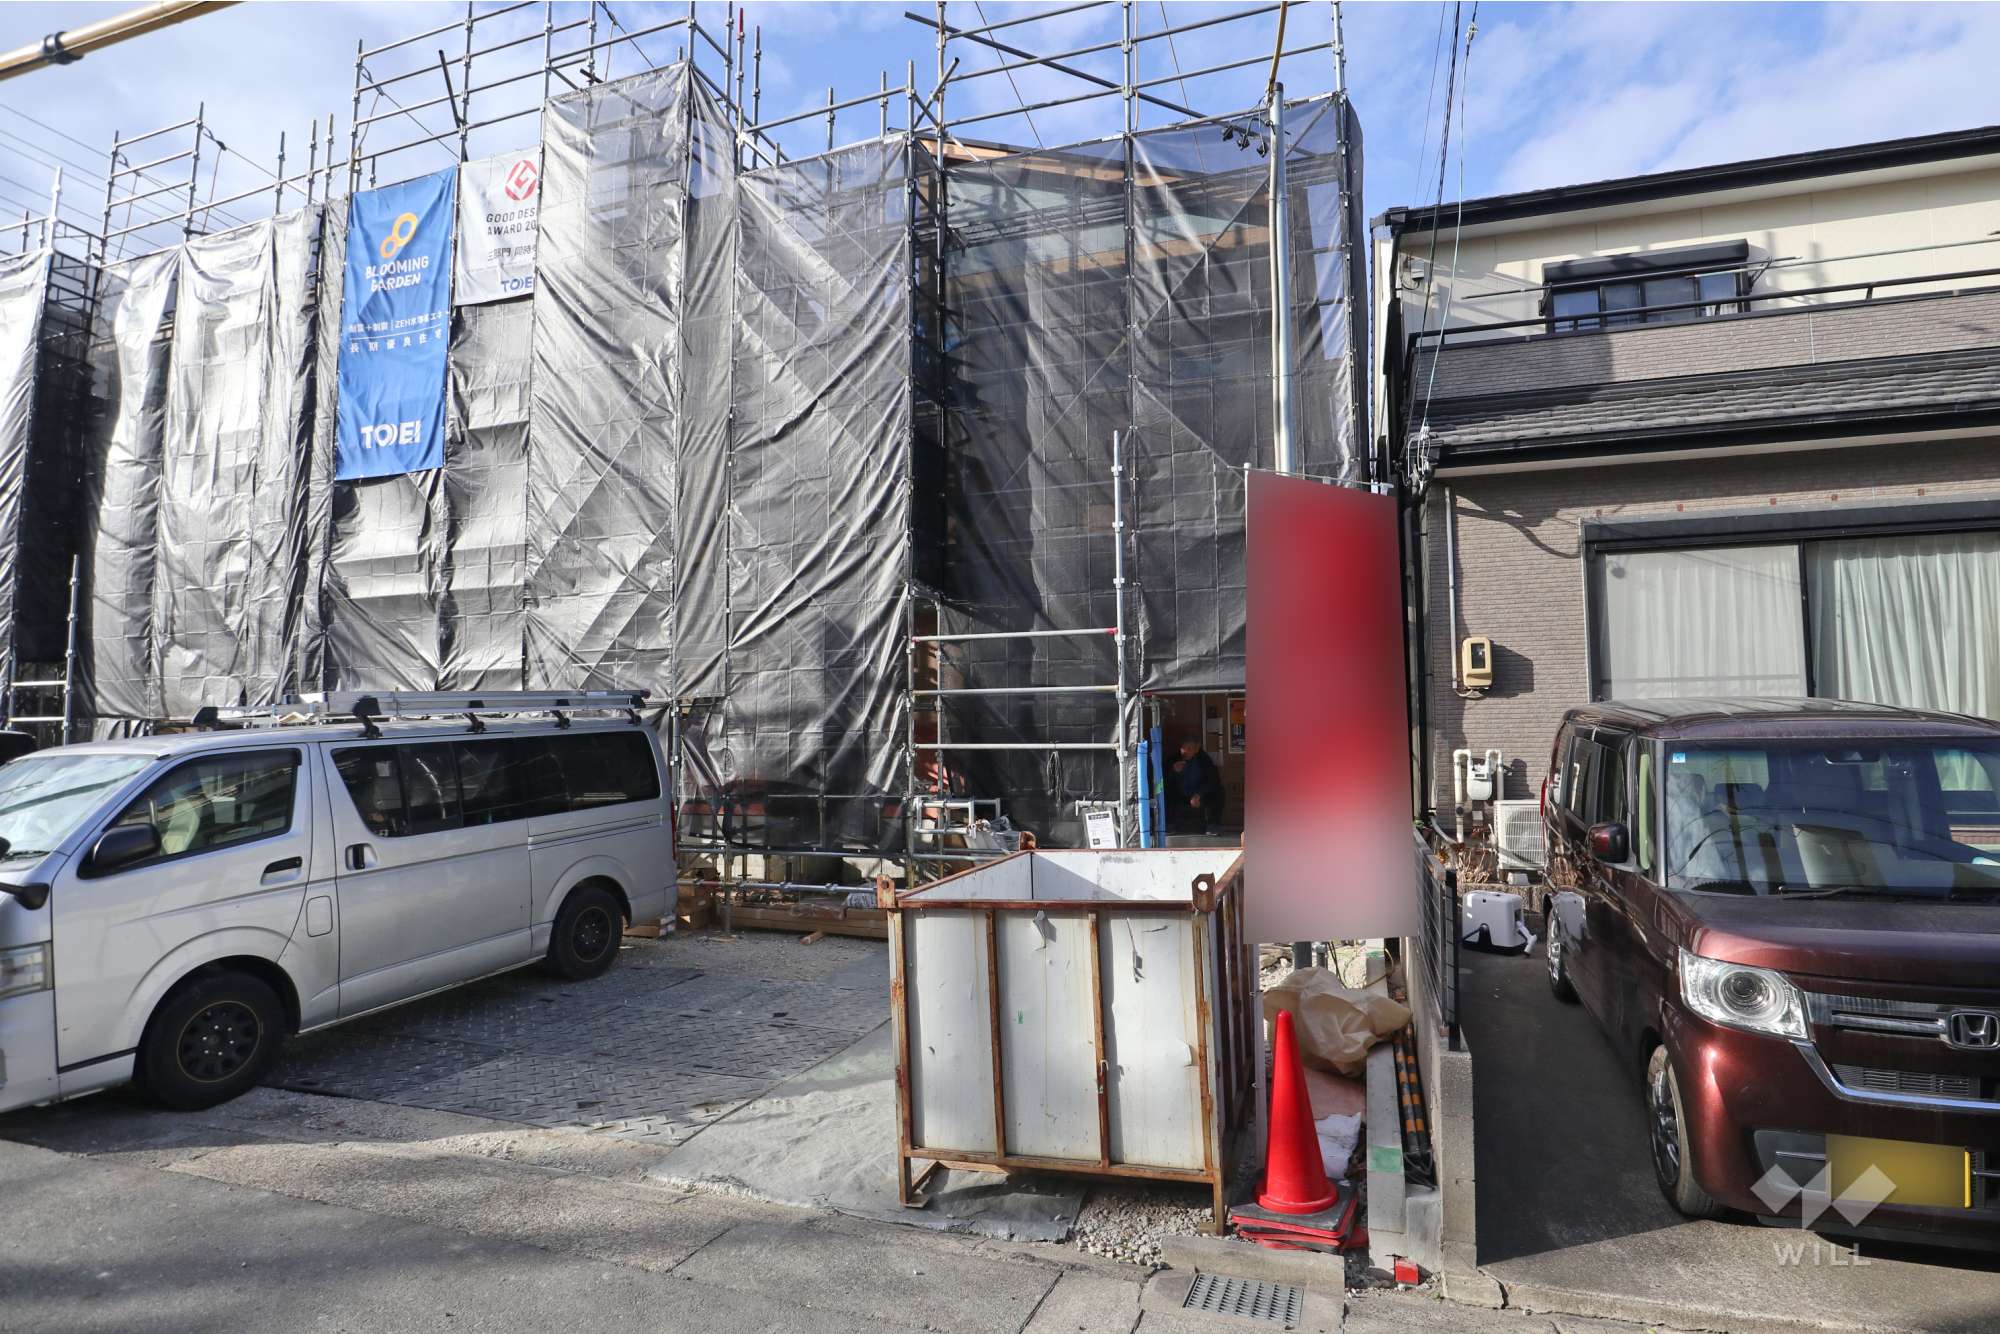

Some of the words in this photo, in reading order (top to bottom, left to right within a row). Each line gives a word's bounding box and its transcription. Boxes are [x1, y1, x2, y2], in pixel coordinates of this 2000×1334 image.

[486, 210, 515, 223] GOOD
[487, 221, 522, 236] AWARD
[365, 255, 429, 279] BLOOMING
[370, 272, 421, 292] GARDEN
[360, 420, 421, 449] TOEI
